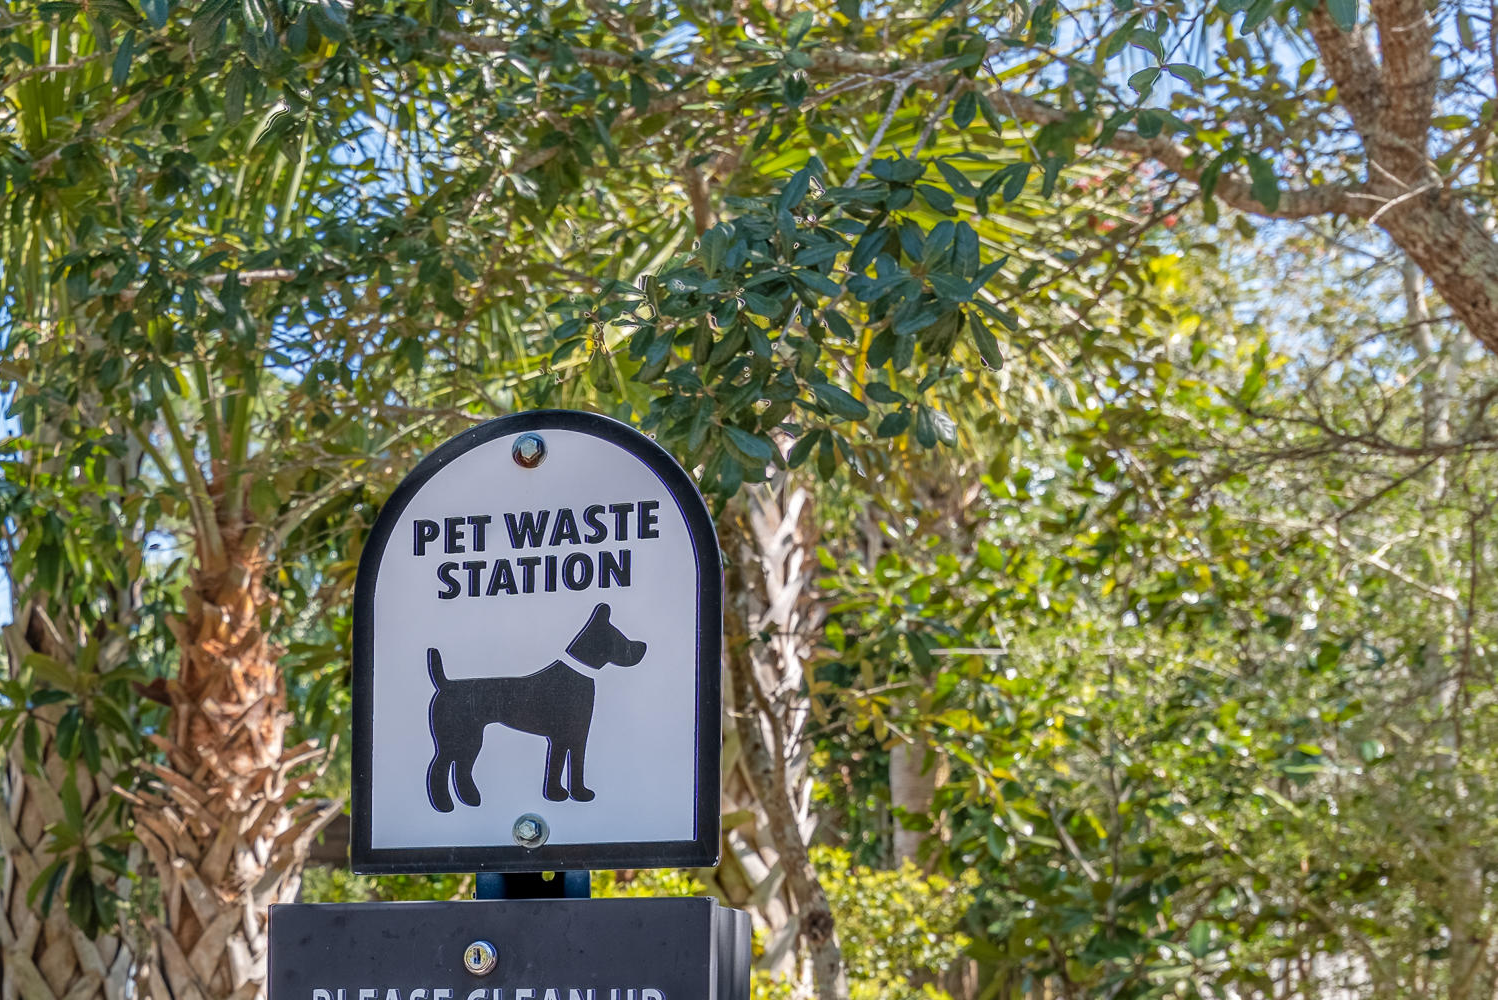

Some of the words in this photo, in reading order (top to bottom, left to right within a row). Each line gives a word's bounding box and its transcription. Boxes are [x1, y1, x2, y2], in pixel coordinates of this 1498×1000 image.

[413, 515, 491, 556] PET
[504, 501, 659, 549] WASTE
[437, 549, 631, 599] STATION
